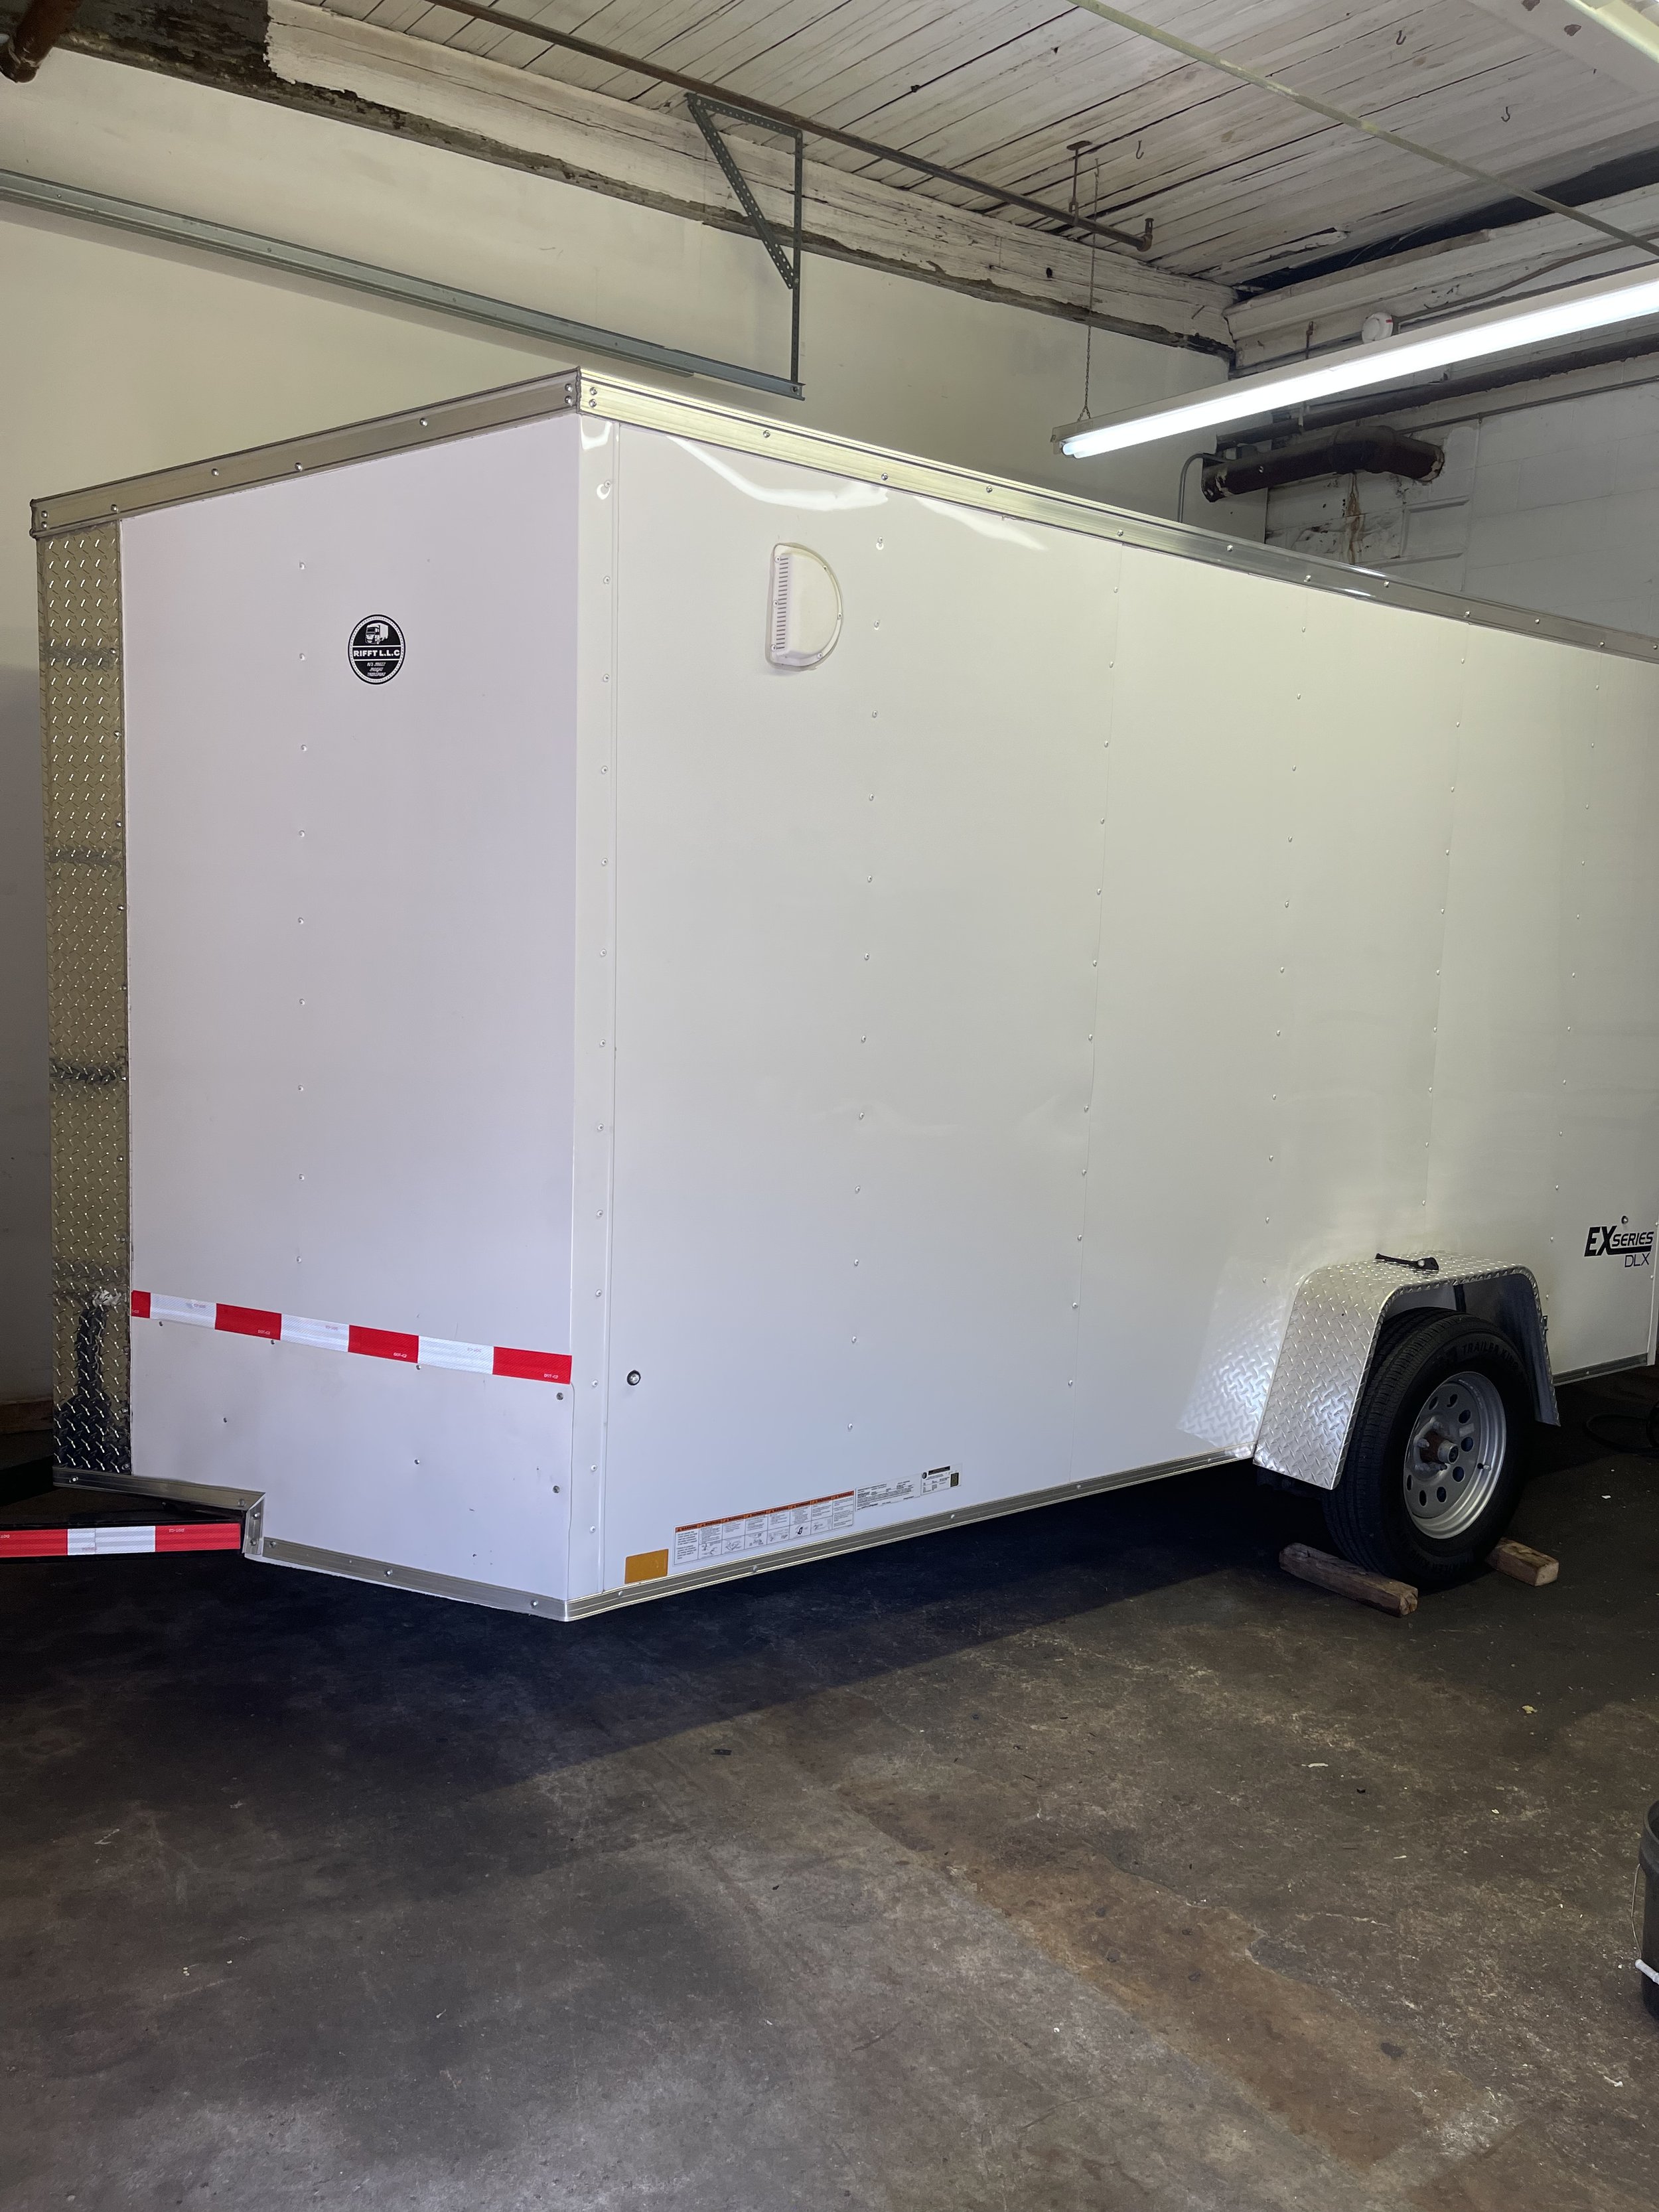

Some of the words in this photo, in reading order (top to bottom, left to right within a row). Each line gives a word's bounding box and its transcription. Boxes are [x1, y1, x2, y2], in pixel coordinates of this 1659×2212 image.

[1584, 1225, 1617, 1257] EX
[1611, 1231, 1654, 1247] SERIES
[1624, 1252, 1650, 1268] DLX
[1461, 1341, 1500, 1355] TRAILER
